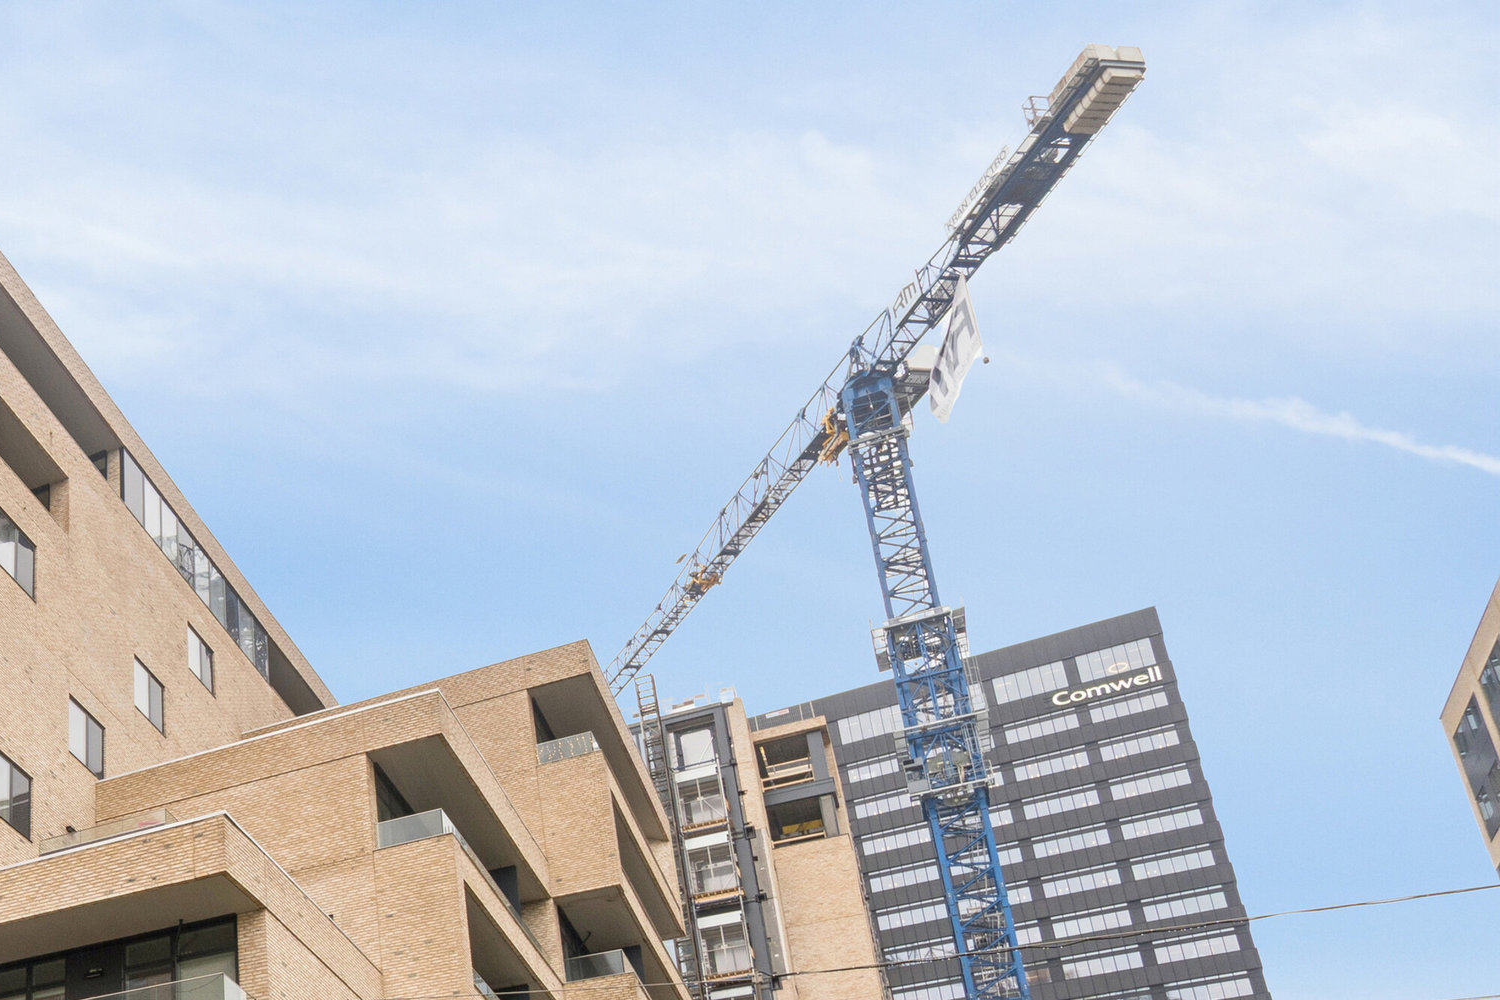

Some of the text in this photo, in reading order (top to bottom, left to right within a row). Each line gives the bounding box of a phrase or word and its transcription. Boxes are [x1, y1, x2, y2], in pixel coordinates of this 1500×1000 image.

[946, 149, 1007, 232] KRAN ELEKTRO
[1052, 665, 1163, 706] Comwell
